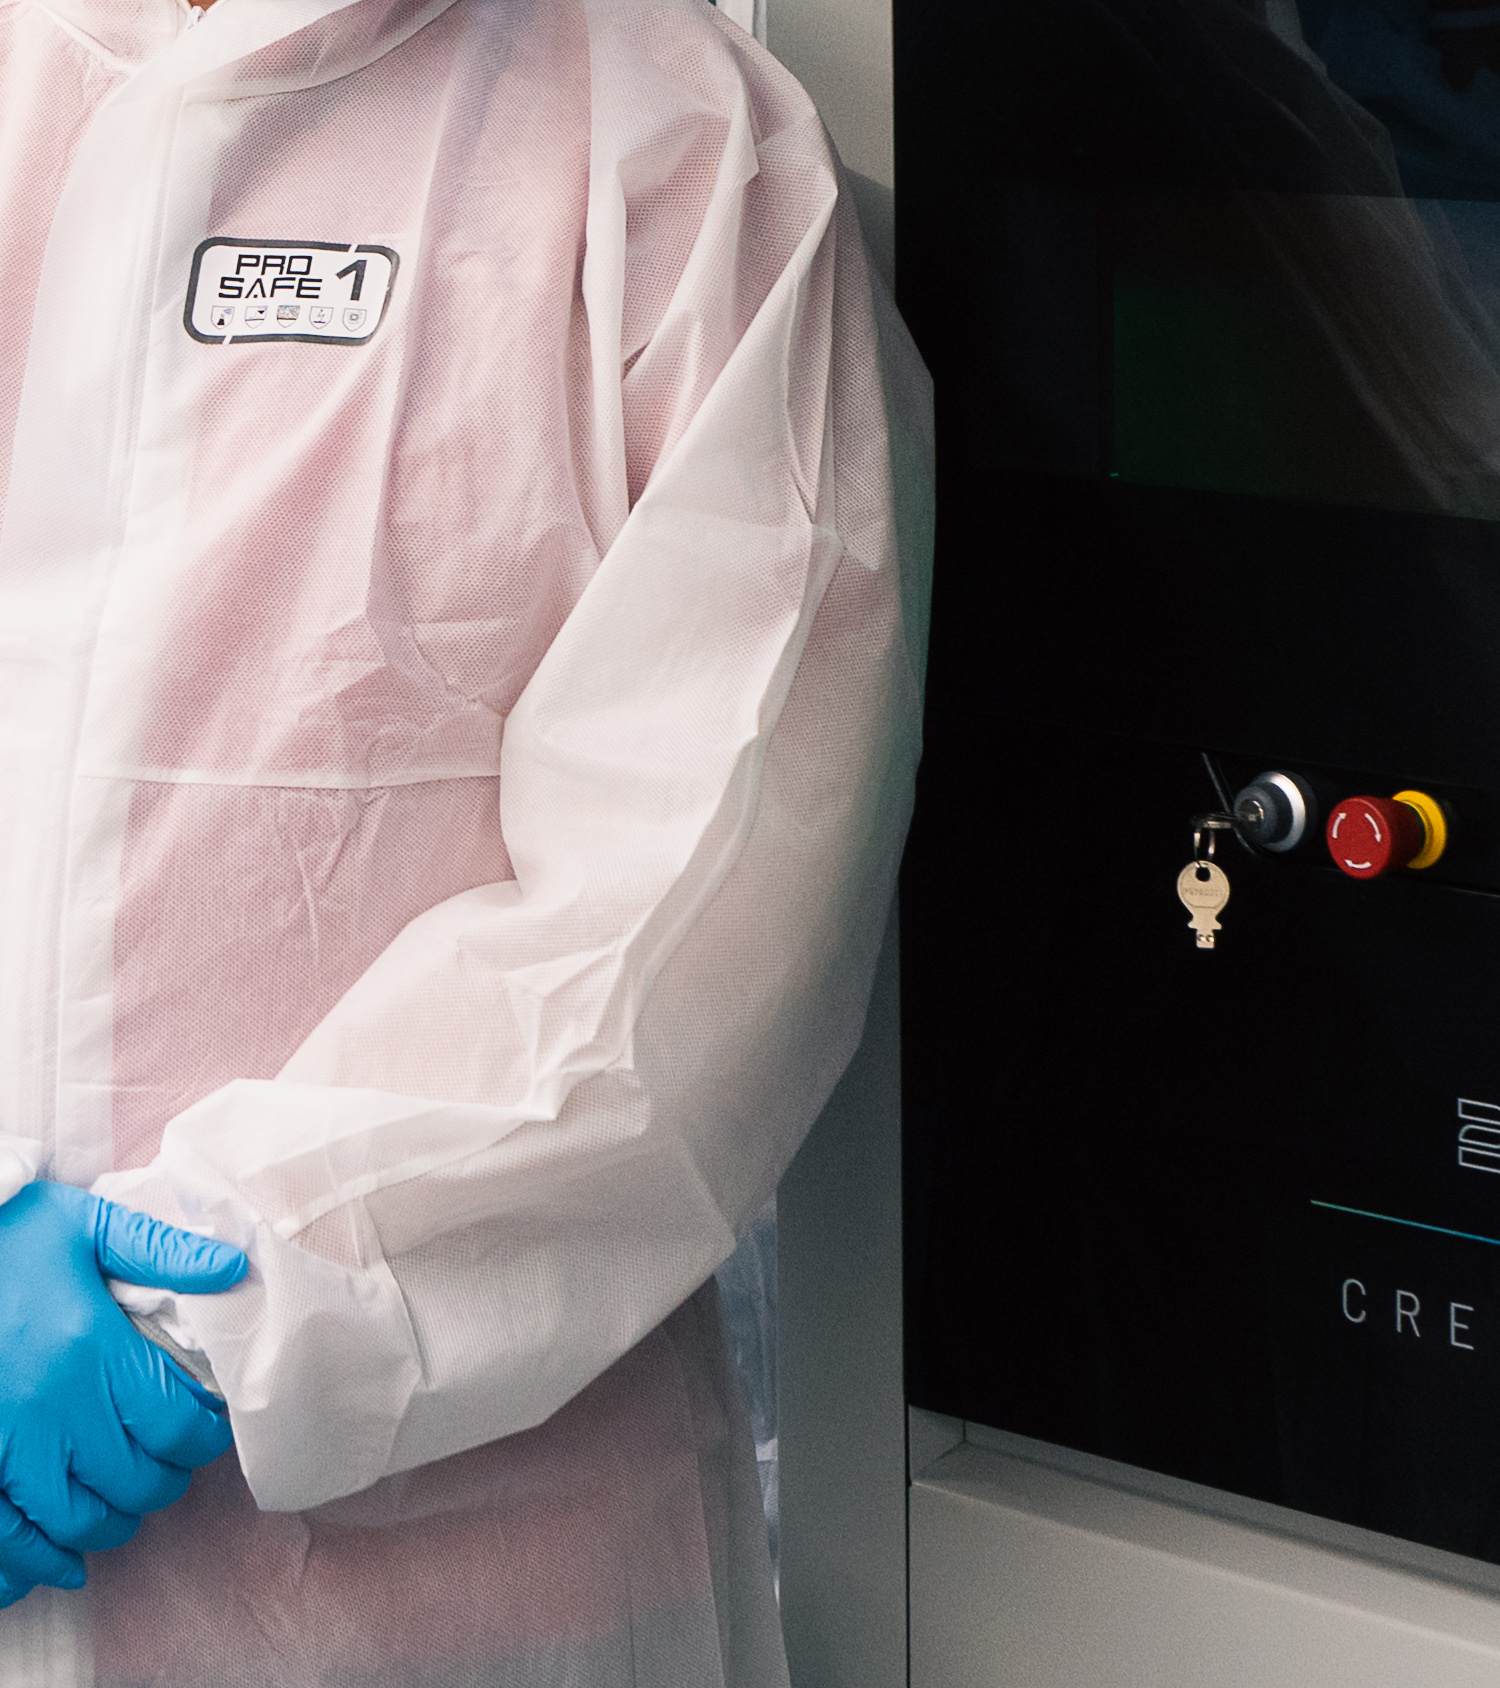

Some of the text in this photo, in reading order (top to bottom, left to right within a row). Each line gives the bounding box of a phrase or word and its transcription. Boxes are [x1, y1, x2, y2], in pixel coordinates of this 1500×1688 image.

[235, 254, 313, 276] PRO
[218, 276, 323, 299] SAFE
[336, 260, 368, 301] 1
